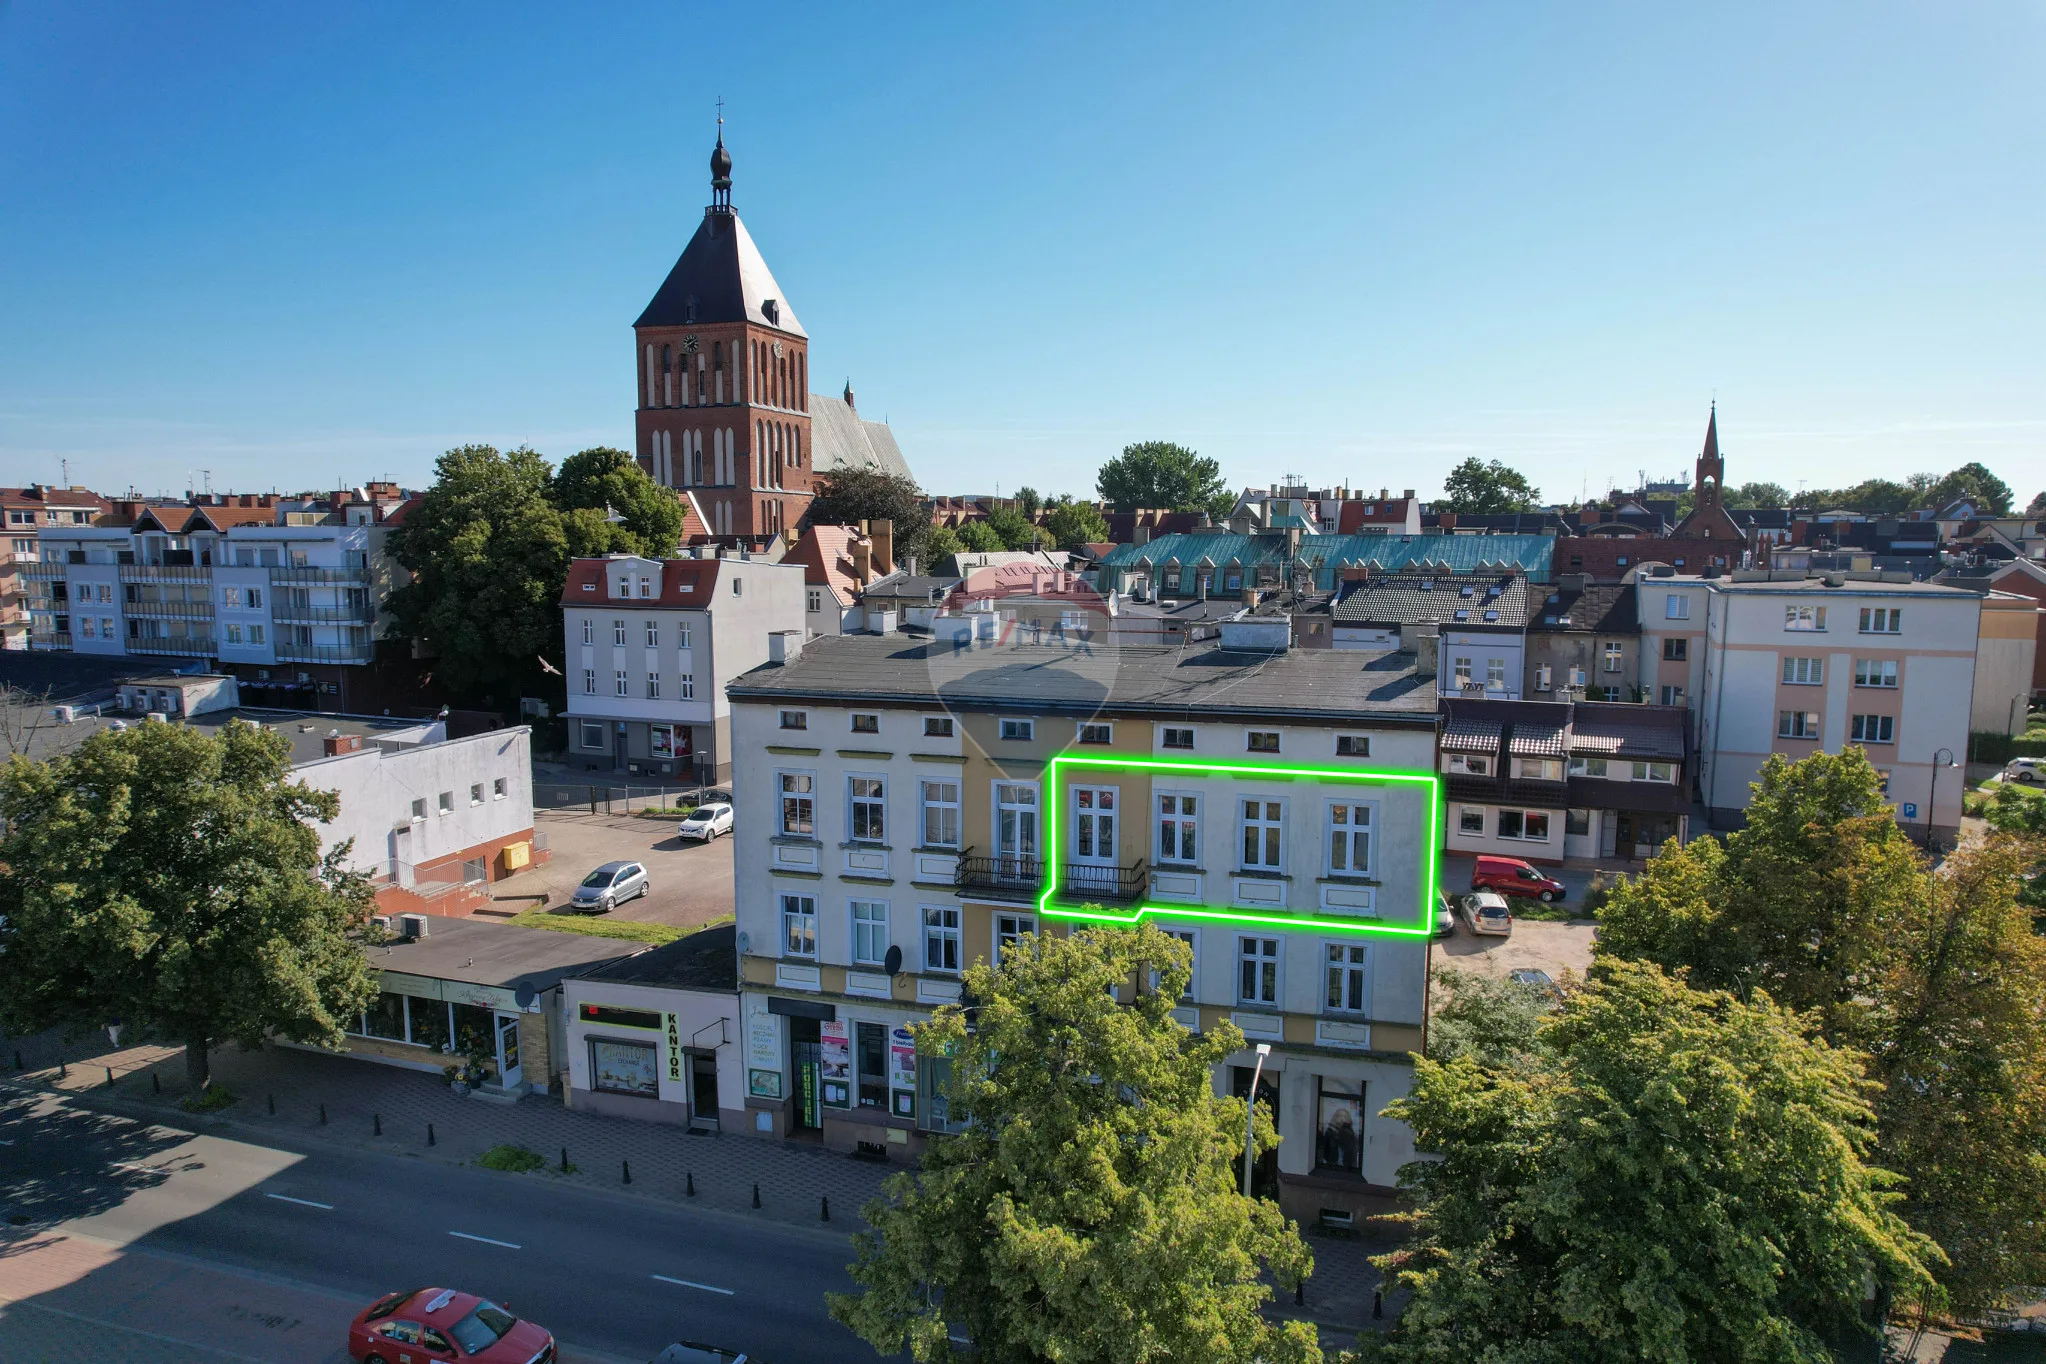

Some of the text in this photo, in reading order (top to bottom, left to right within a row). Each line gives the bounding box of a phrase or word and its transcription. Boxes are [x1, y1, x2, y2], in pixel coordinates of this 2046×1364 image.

[1906, 805, 1914, 814] P
[608, 1044, 648, 1060] KANTOR
[668, 1013, 679, 1077] KANTOR
